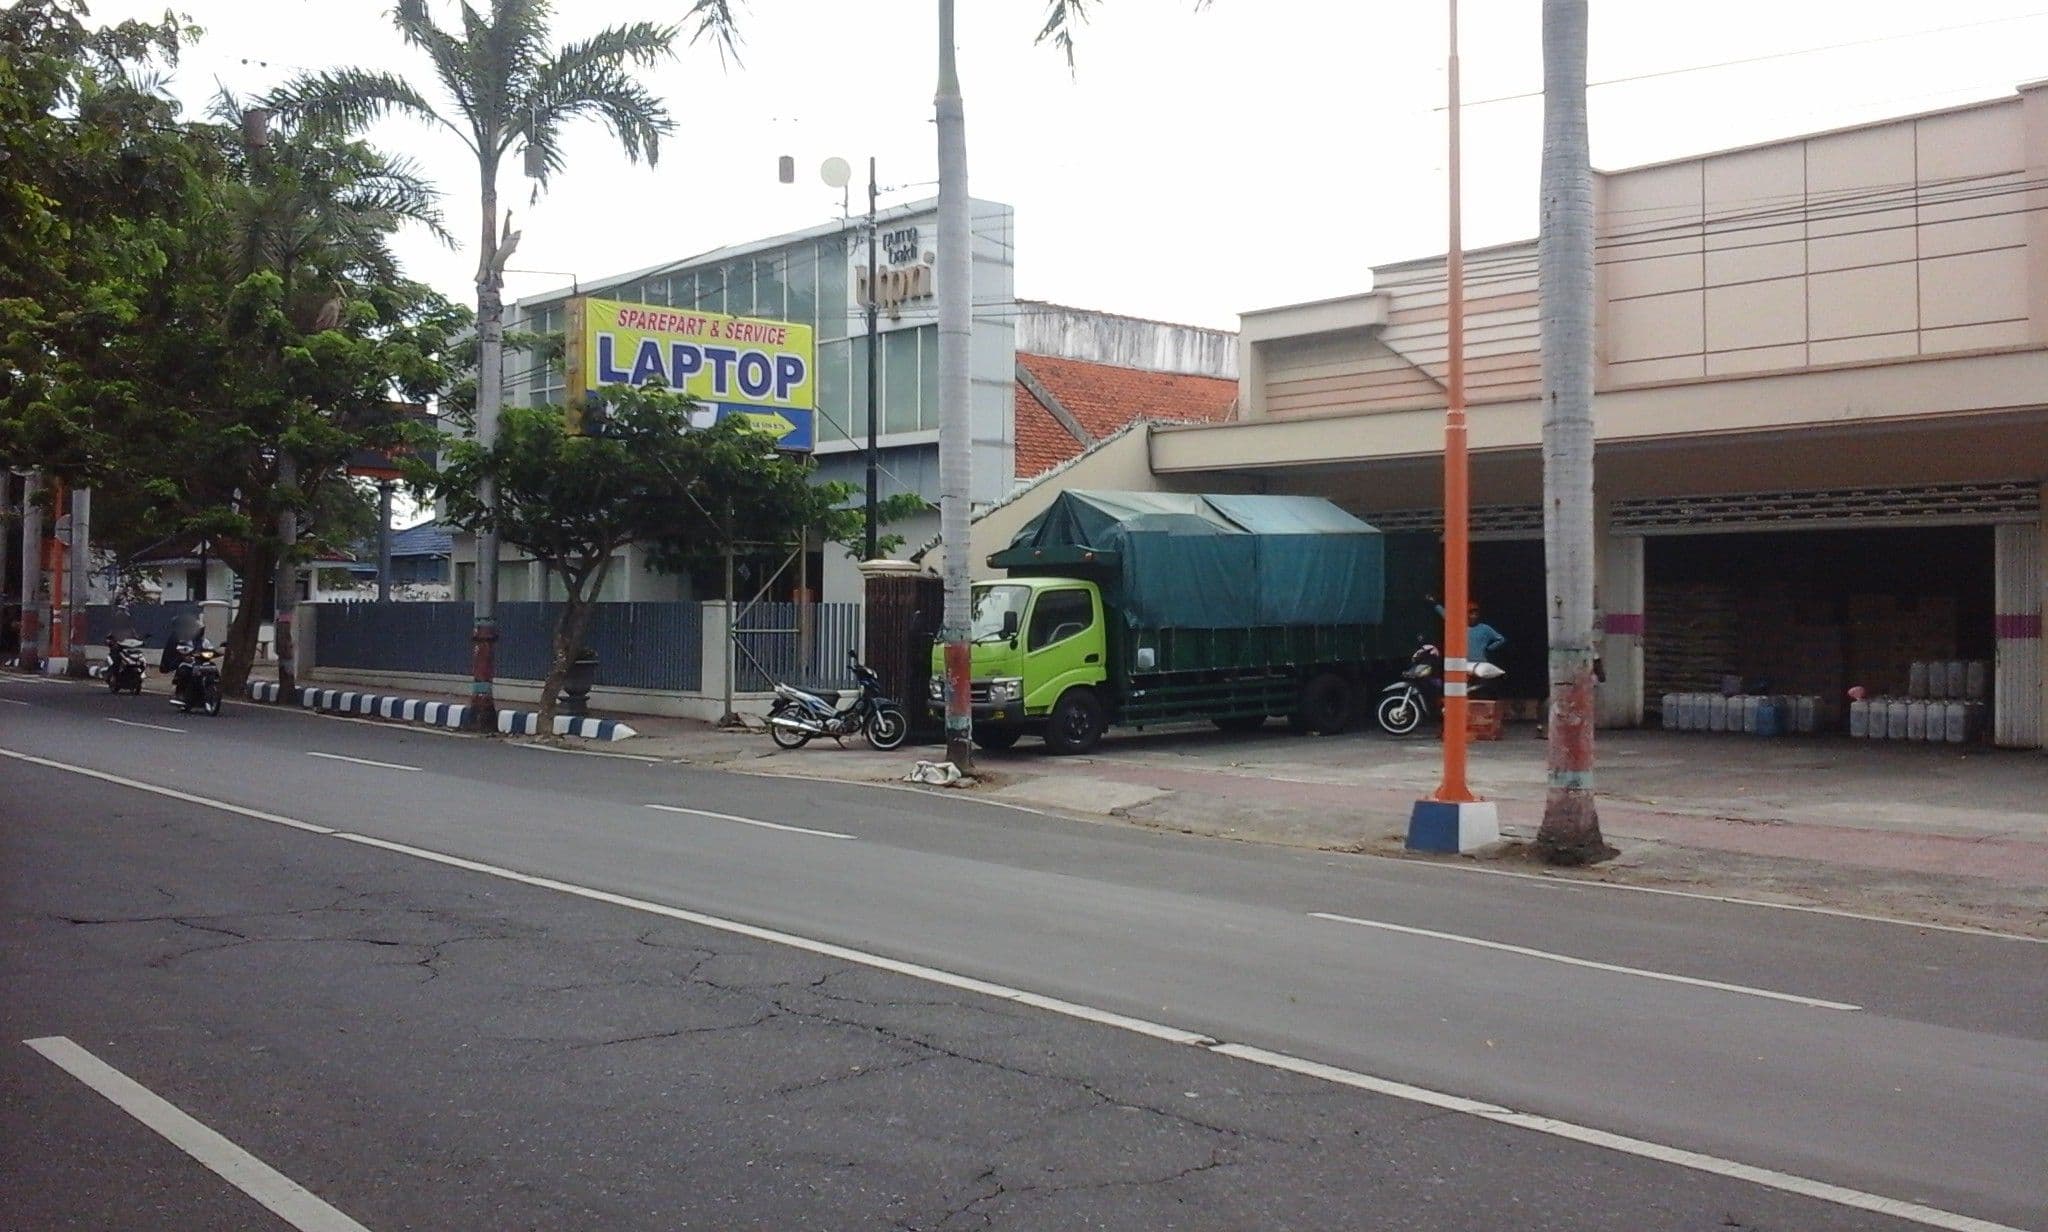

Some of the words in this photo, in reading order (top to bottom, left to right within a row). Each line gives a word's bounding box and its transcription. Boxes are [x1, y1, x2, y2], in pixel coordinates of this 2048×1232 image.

[618, 310, 706, 334] SPAREPART
[711, 322, 719, 337] &
[726, 323, 786, 345] SERVICE
[599, 335, 804, 399] LAPTOP
